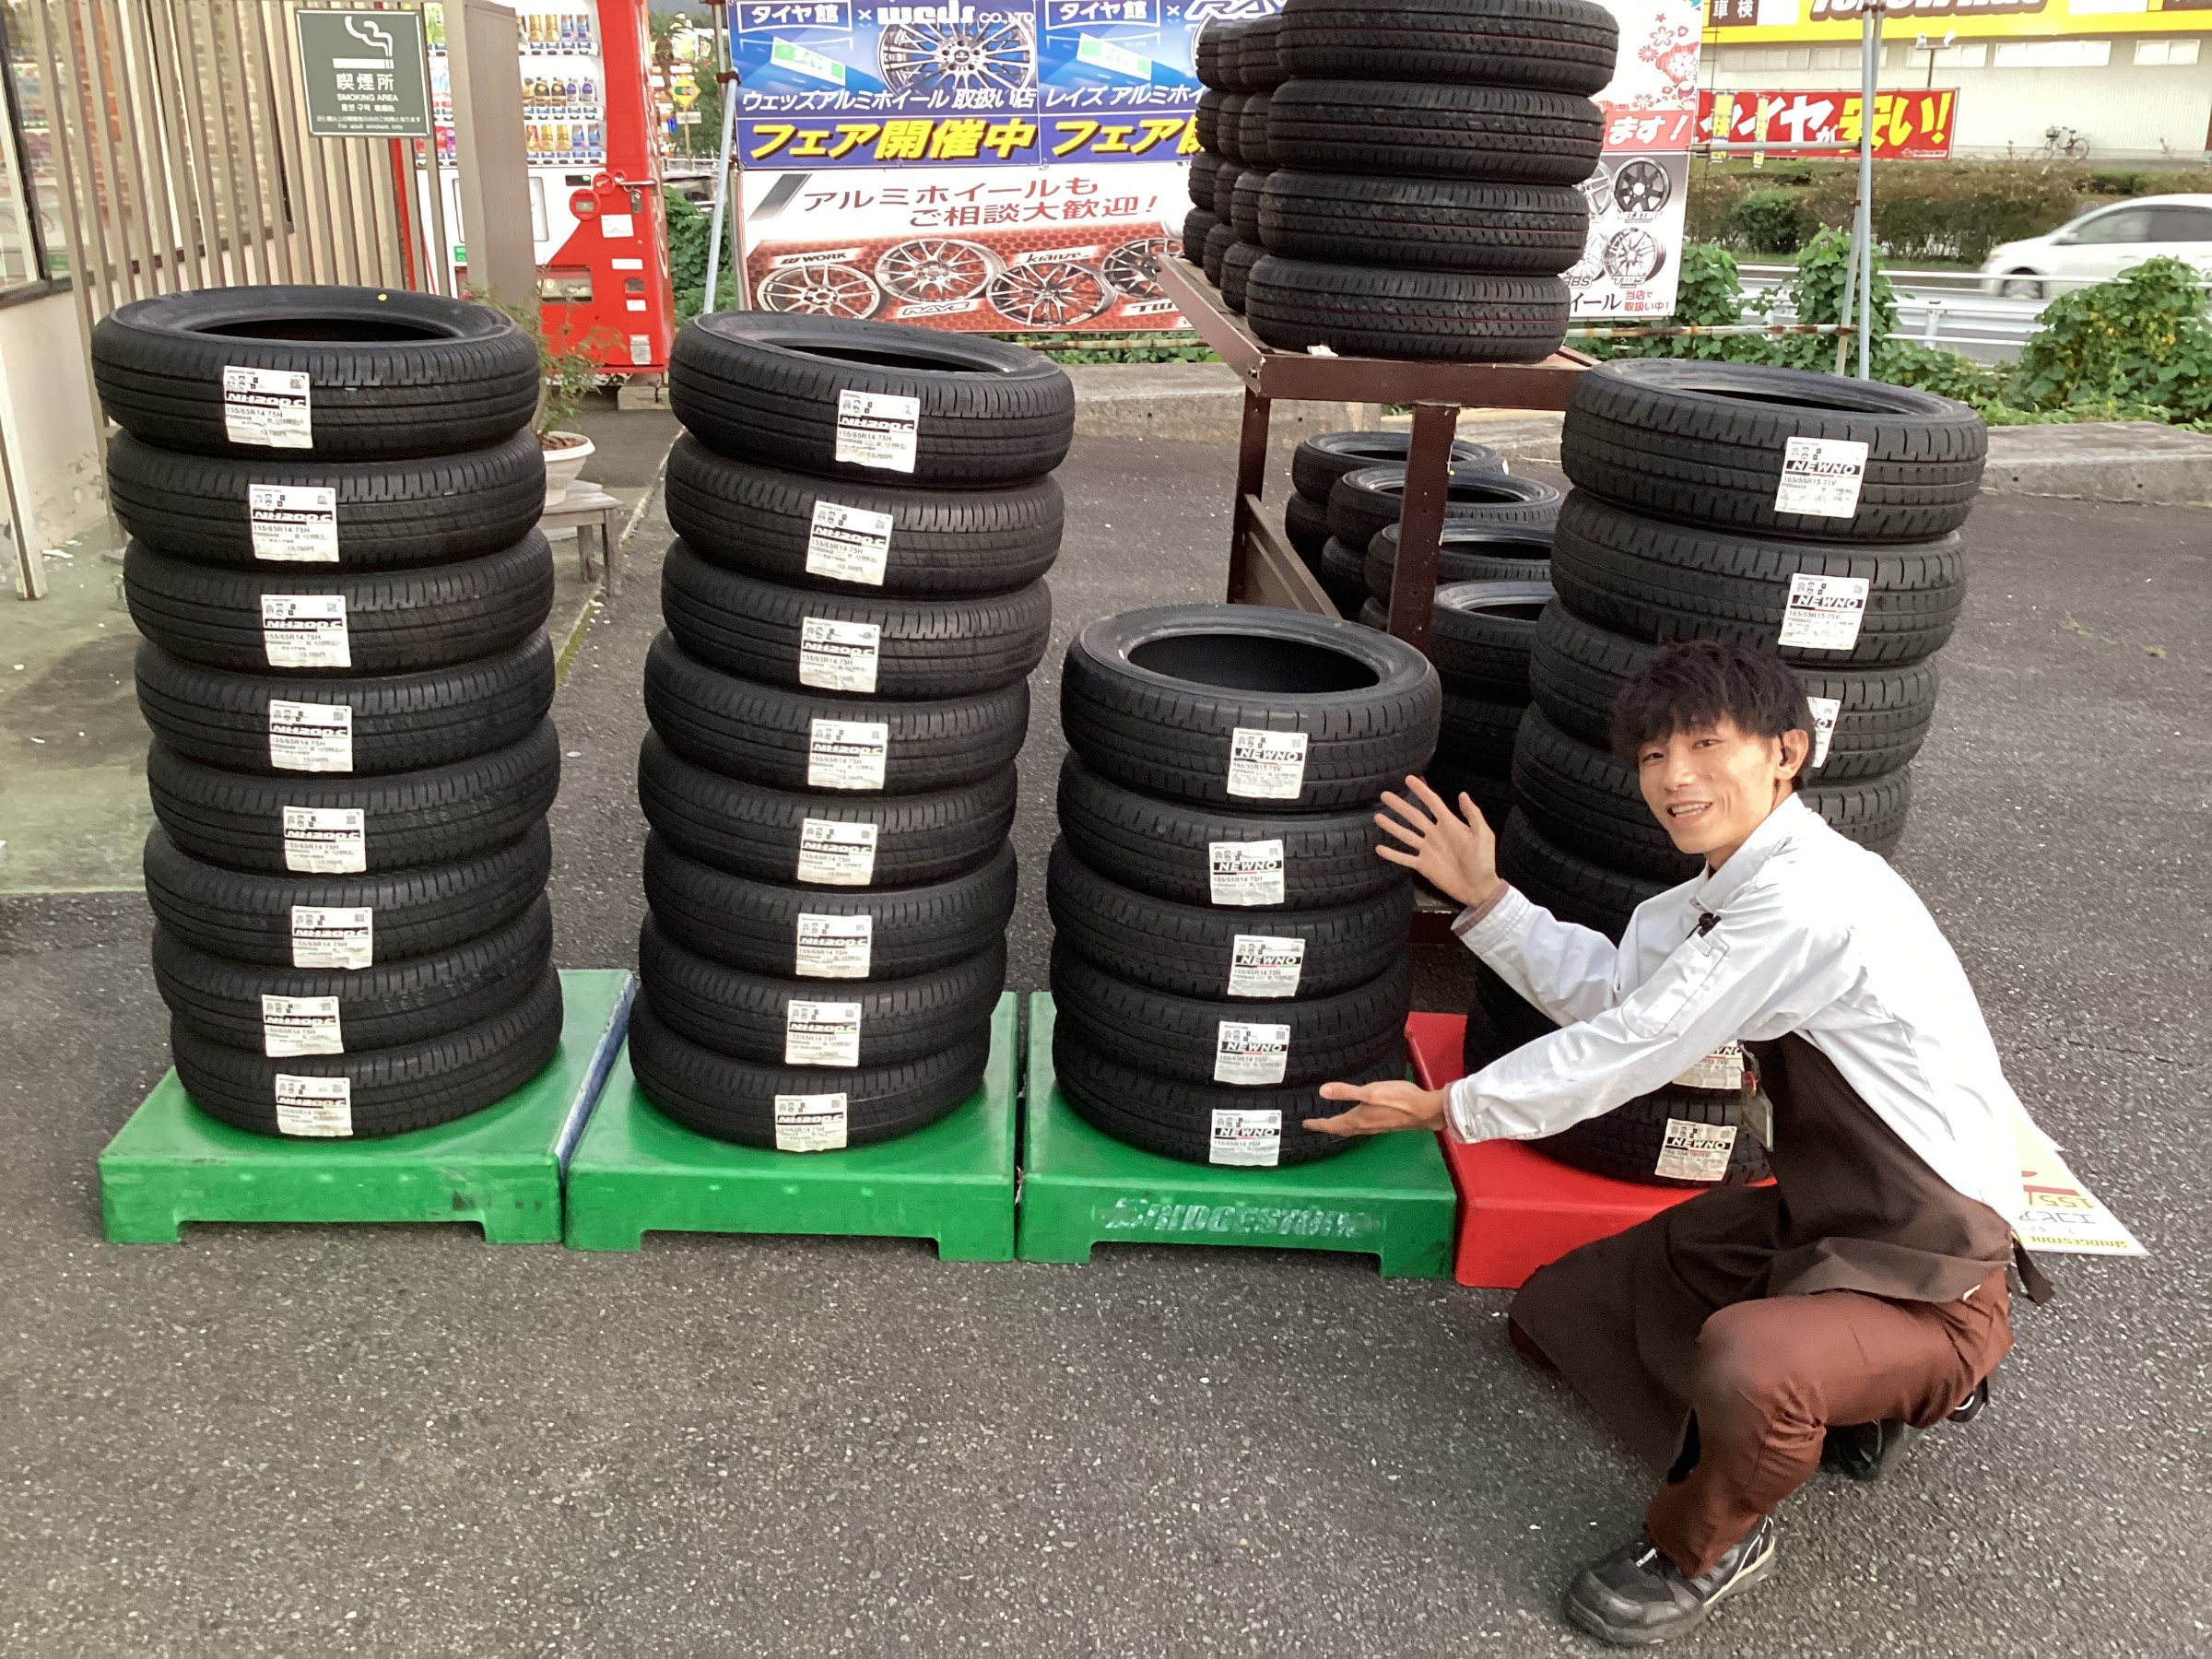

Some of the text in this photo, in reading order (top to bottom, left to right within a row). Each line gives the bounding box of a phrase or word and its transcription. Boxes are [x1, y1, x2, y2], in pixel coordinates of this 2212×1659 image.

[751, 4, 839, 23] タイヤ館
[877, 0, 975, 24] weds
[1060, 2, 1147, 20] タイヤ館
[1712, 0, 1753, 19] 車検
[336, 73, 394, 90] 喫煙所
[743, 88, 1037, 111] ウェッズアルミホイール 取扱い店
[1045, 86, 1109, 107] レイズ
[750, 118, 1038, 160] フェア開催中
[805, 177, 1098, 211] アルミホイールも
[802, 252, 847, 263] WORK
[1626, 290, 1653, 300] 当店で
[902, 301, 970, 315] RAYS
[227, 406, 265, 416] 155/65R14
[839, 430, 876, 441] 155/65R14
[1791, 460, 1856, 475] NEWNO
[811, 539, 847, 552] 155/65R14
[1799, 594, 1858, 608] NEWNO
[1240, 747, 1298, 761] NEWNO
[1218, 860, 1277, 871] NEWNO
[1241, 955, 1297, 964] NEWNO
[1226, 1041, 1282, 1052] NEWNO
[1219, 1127, 1275, 1136] NEWNO
[1671, 1137, 1726, 1149] NEWNO
